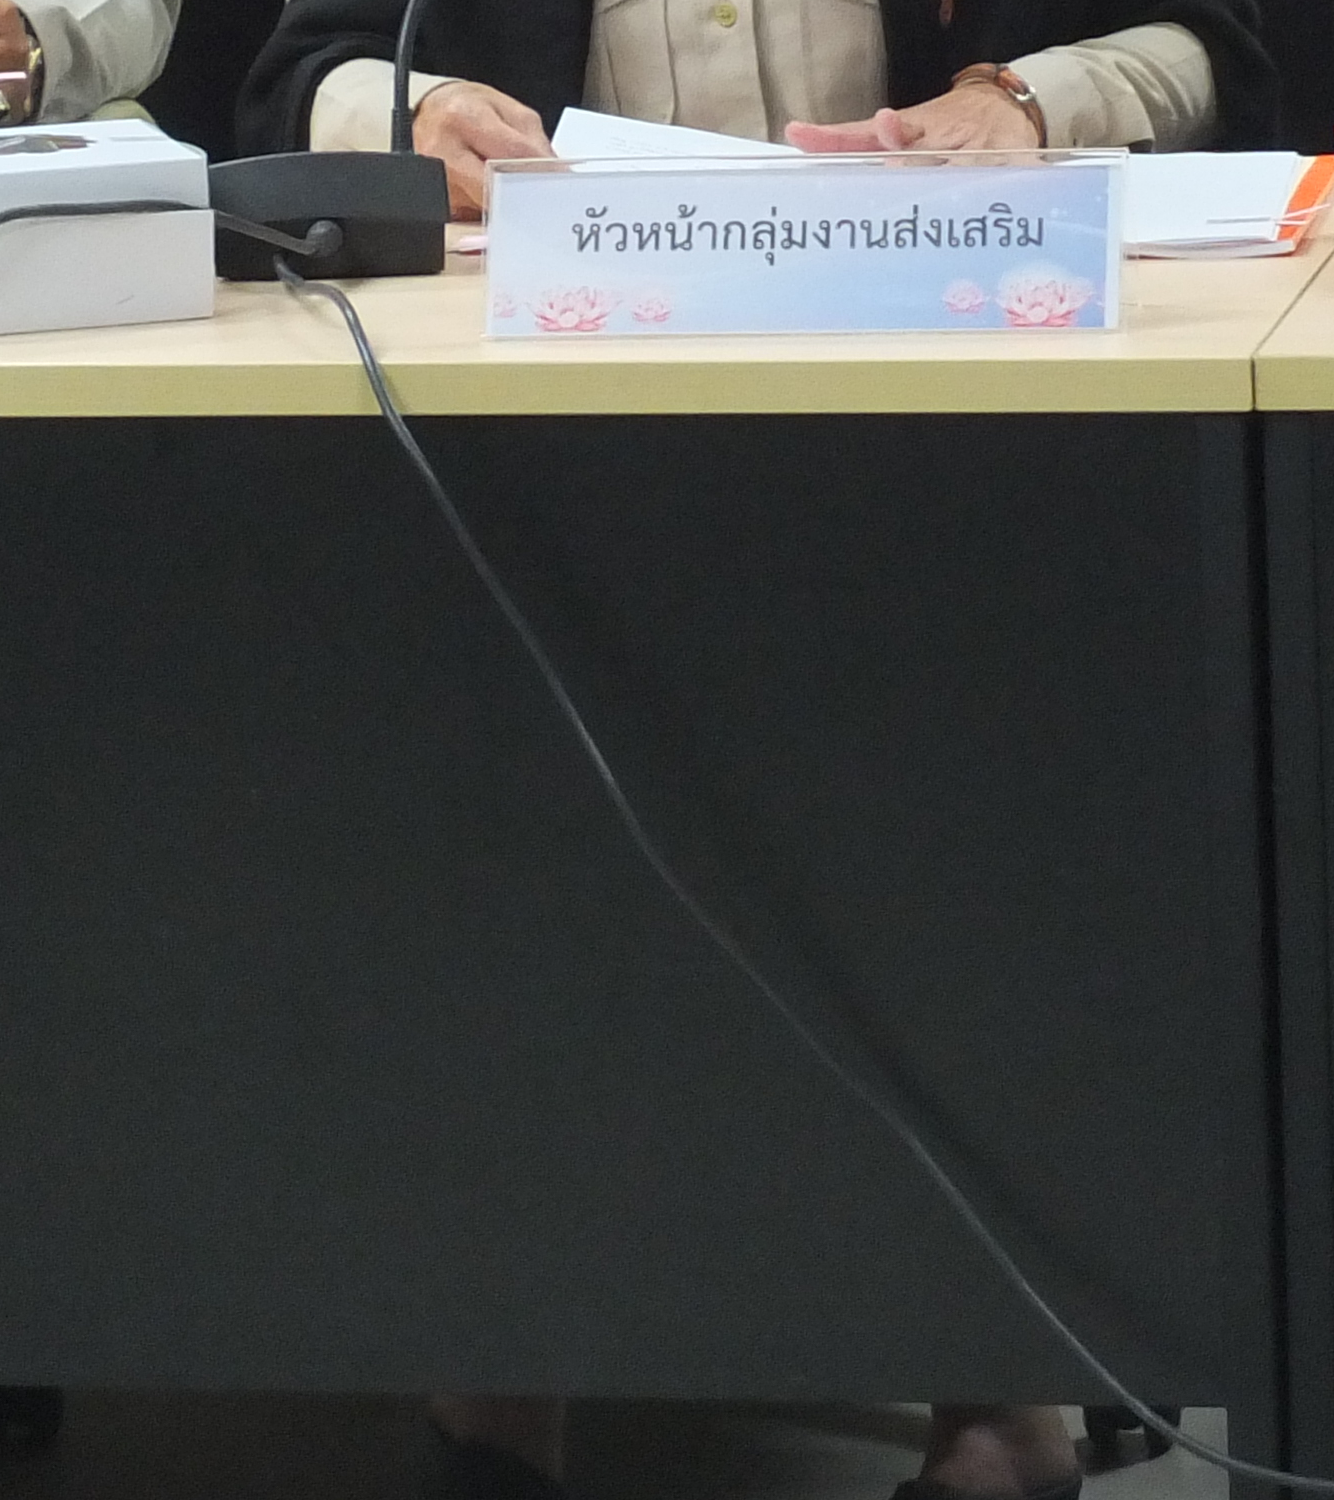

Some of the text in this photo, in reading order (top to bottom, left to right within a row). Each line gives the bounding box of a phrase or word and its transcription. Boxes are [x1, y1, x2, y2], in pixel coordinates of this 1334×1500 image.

[571, 202, 1045, 267] หัวหน้ากลุ่มงานส่งเสริม
